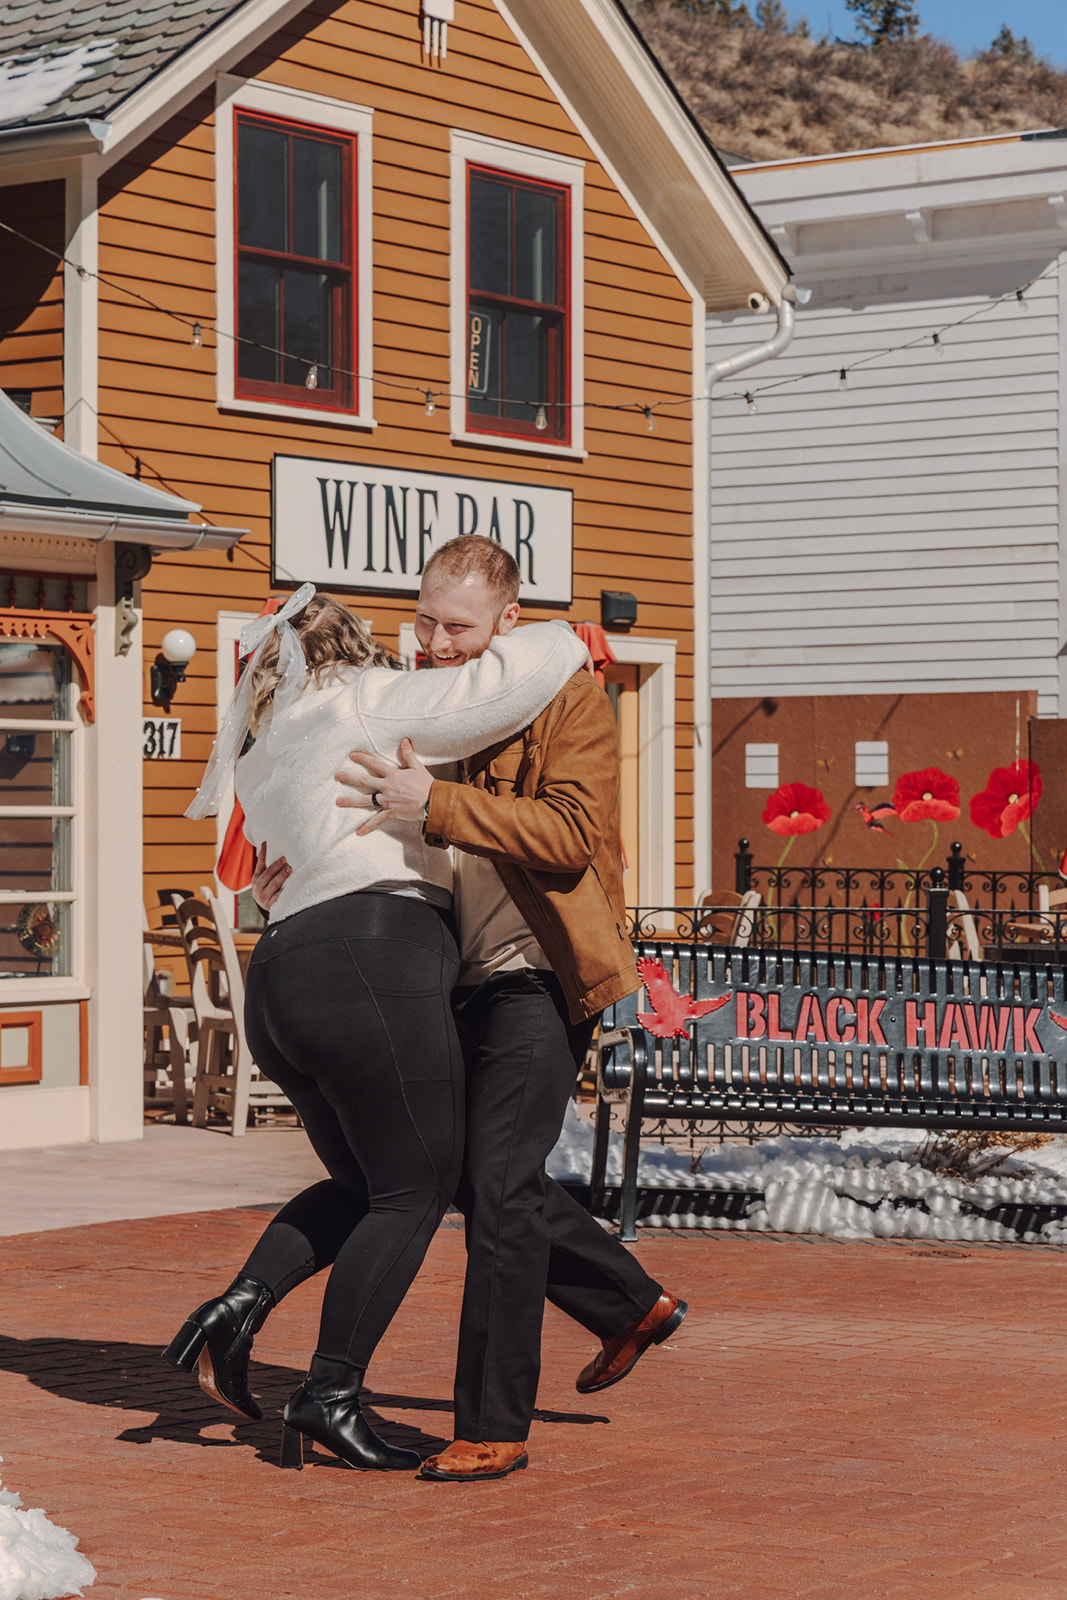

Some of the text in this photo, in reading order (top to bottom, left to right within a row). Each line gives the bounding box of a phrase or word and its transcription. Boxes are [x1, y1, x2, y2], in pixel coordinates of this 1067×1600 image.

[468, 316, 482, 388] OPEN
[316, 477, 439, 575] WINE
[143, 721, 179, 758] 317
[736, 991, 1045, 1054] BLACK HAWK
